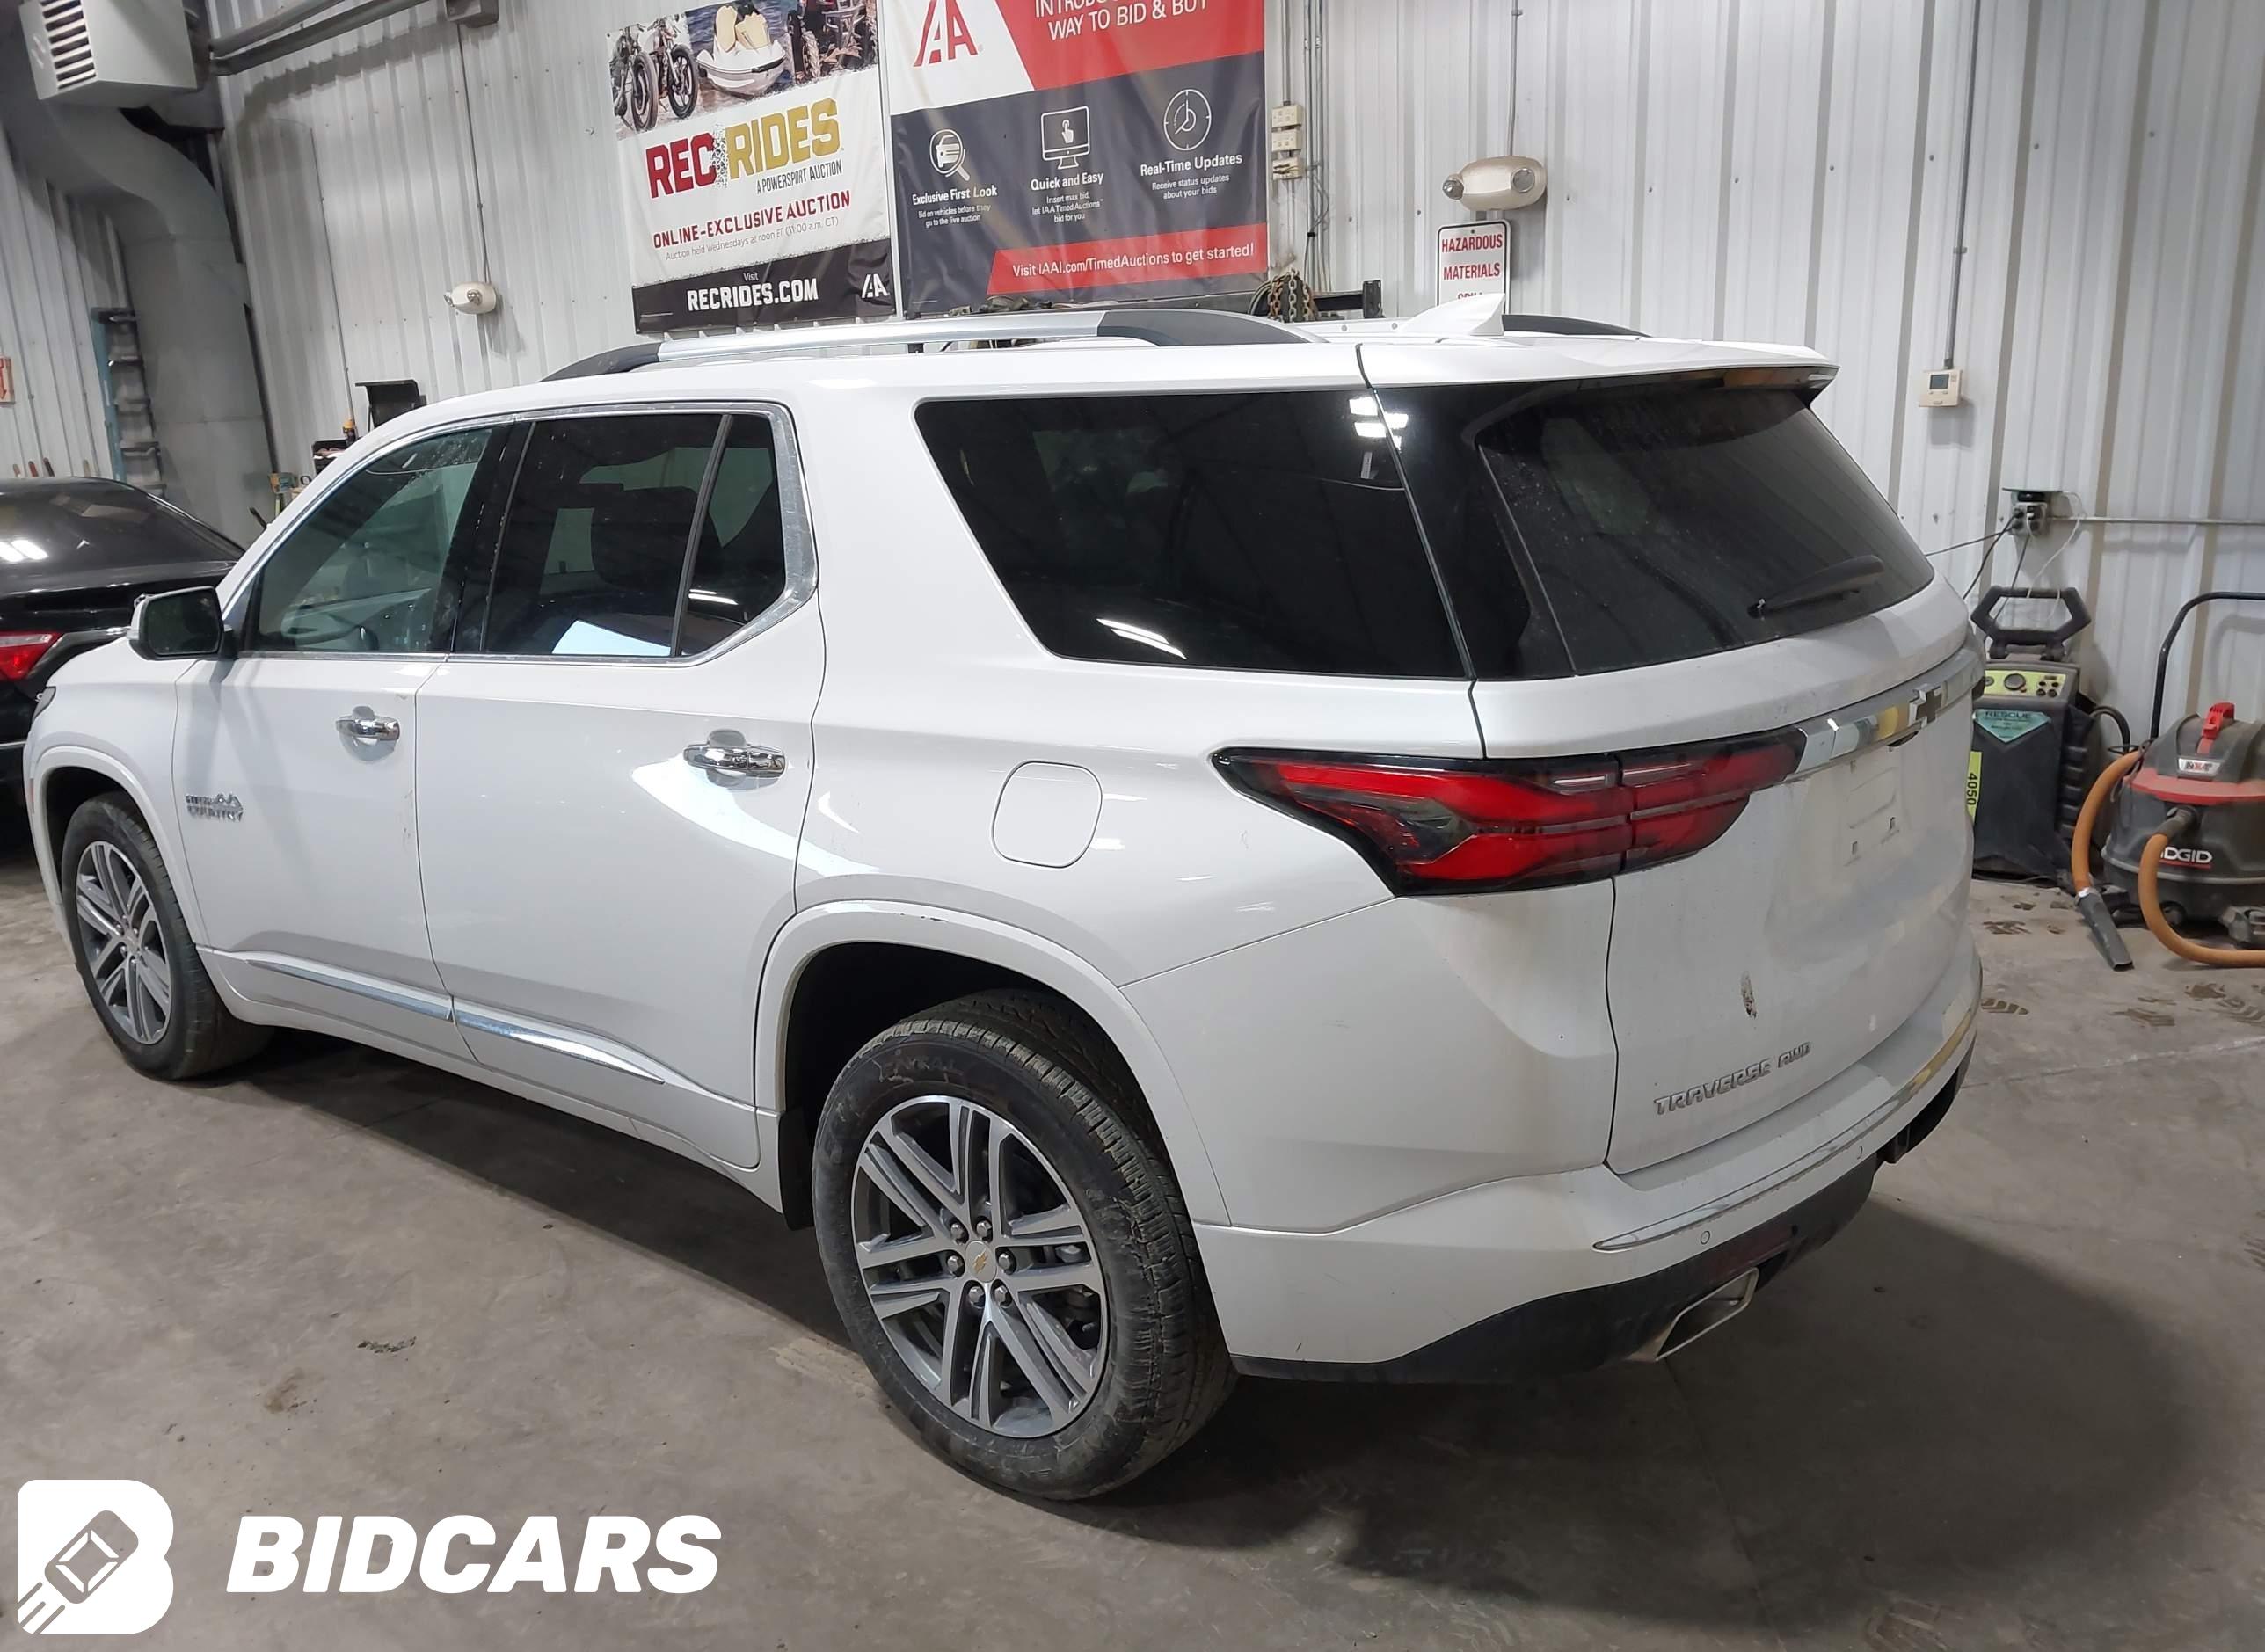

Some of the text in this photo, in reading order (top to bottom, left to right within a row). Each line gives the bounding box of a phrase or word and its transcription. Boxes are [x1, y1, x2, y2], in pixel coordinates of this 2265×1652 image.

[1048, 14, 1084, 40] WAY
[1089, 9, 1111, 32] TO
[1117, 3, 1147, 25] BID
[1152, 0, 1167, 19] &
[645, 98, 841, 199] REC RIDES
[1140, 154, 1243, 176] Real-Time Updates
[756, 159, 843, 194] A POWERSPORT AUCTION
[1031, 171, 1104, 191] Quick and Easy
[1152, 174, 1230, 191] Receive status updates
[912, 185, 998, 206] Exclusive First Look
[1046, 194, 1065, 204] Insert
[1163, 185, 1218, 200] about your bids
[934, 207, 957, 216] vehicles
[958, 205, 975, 214] before
[976, 203, 992, 212] they
[1056, 203, 1074, 212] Timed
[653, 190, 850, 249] ONLINE-EXCLUSIVE AUCTION
[960, 214, 981, 223] auction
[1054, 215, 1065, 223] bid
[1074, 213, 1086, 222] you
[666, 249, 690, 260] Auction
[692, 245, 705, 255] held
[705, 237, 749, 252] Wednesdays
[758, 232, 775, 241] noon
[825, 216, 839, 227] CT)
[1441, 234, 1504, 253] HAZARDOUS
[1012, 242, 1255, 277] Visit IAAI.com/TimedAuctions to get started!
[743, 272, 760, 282] Visit
[1443, 262, 1501, 280] MATERIALS
[686, 278, 819, 311] RECRIDES.COM
[1966, 772, 1978, 805] 4050
[1653, 1041, 1812, 1115] TRAVERSE AWD
